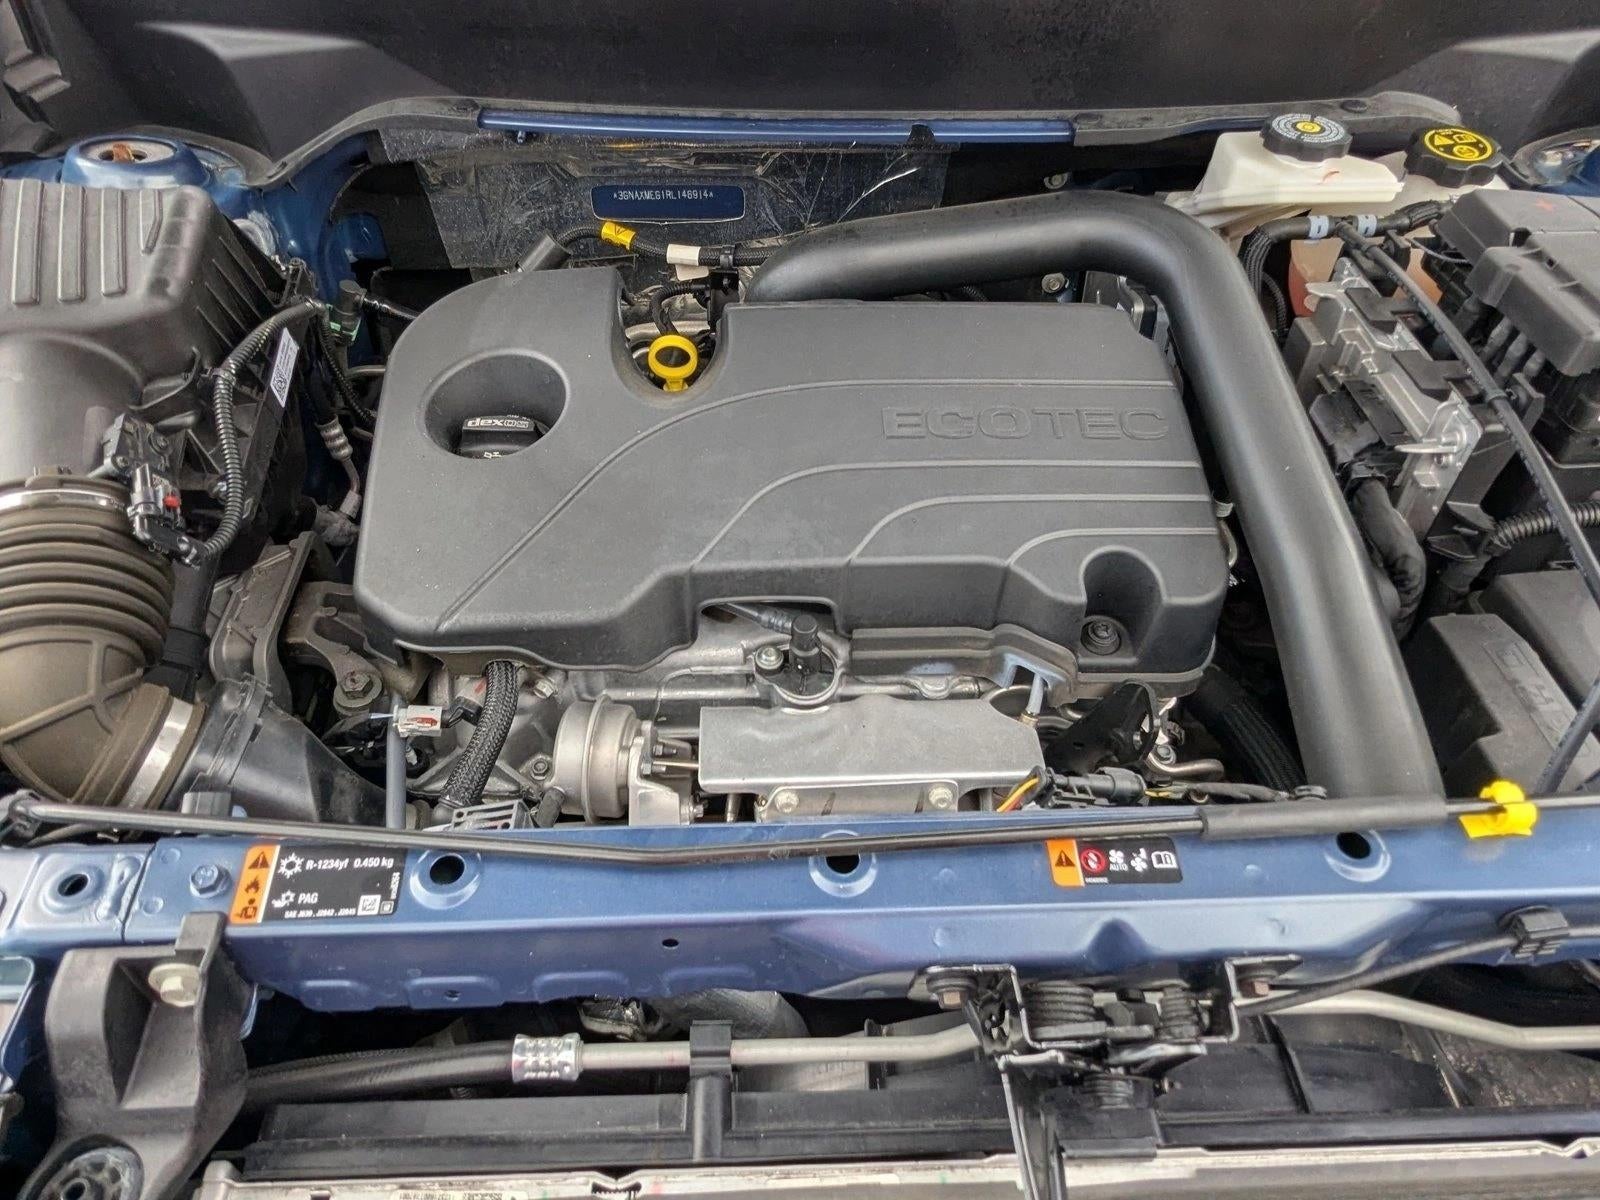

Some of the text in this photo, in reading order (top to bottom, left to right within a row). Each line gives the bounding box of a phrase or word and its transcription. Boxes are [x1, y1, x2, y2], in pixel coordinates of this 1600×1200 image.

[467, 418, 529, 428] dexos
[881, 407, 1169, 440] ECOTEC
[305, 857, 394, 870] R-1234yf 0.450 kg
[1109, 863, 1128, 871] AUTO
[297, 892, 319, 905] PAG
